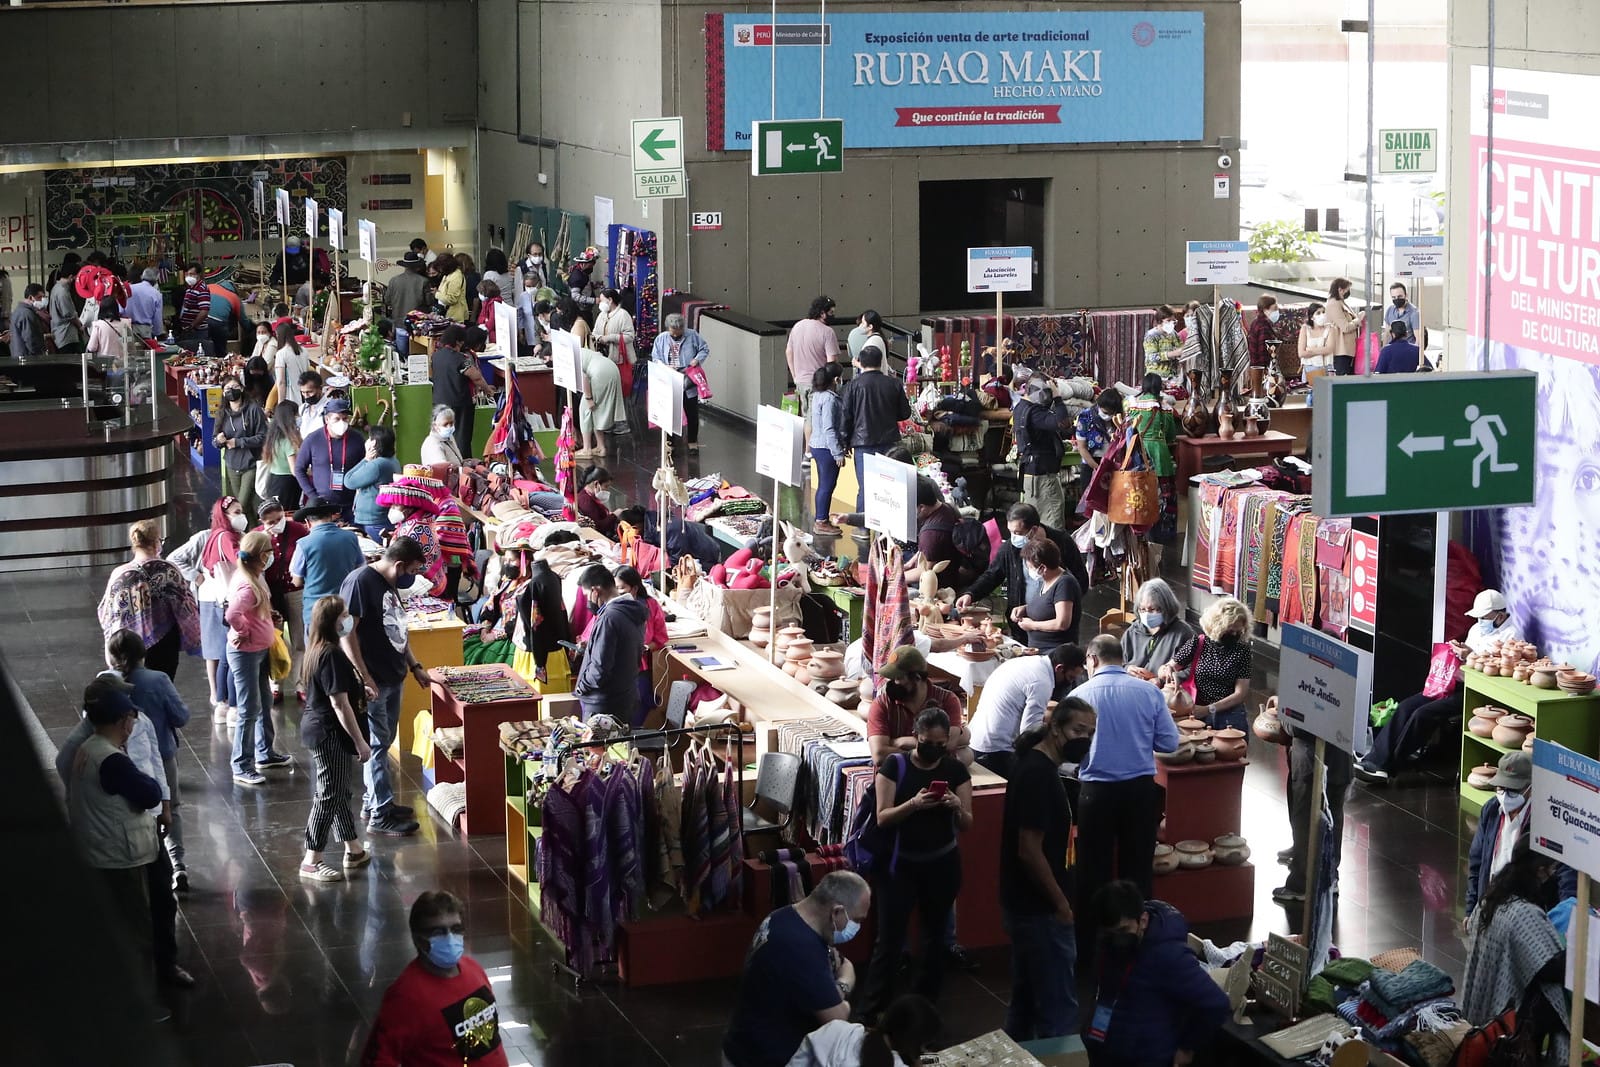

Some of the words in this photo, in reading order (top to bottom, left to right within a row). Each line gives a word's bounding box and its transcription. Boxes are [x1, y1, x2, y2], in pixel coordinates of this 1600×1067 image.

[865, 32, 933, 46] Exposición
[936, 33, 972, 44] venta
[974, 31, 990, 42] de
[992, 32, 1019, 42] arte
[1022, 30, 1090, 42] tradicional
[853, 50, 990, 86] RURAQ
[1000, 50, 1103, 83] MAKI
[993, 85, 1044, 98] HECHO
[1047, 86, 1056, 97] A
[1059, 84, 1103, 97] MANO
[912, 111, 933, 124] Que
[935, 110, 981, 122] continúe
[983, 111, 993, 121] la
[996, 110, 1045, 121] tradición
[1385, 132, 1430, 149] SALIDA
[1395, 153, 1421, 169] EXIT
[641, 175, 677, 184] SALIDA
[649, 186, 670, 194] EXIT
[694, 213, 720, 224] E-01
[1511, 290, 1534, 313] DEL
[1522, 319, 1538, 341] DE
[1541, 324, 1599, 354] CULTURA
[1298, 679, 1316, 695] Arte
[1316, 687, 1341, 707] Andino
[1547, 795, 1579, 813] Asociación
[1580, 807, 1587, 817] de
[1550, 805, 1561, 819] El
